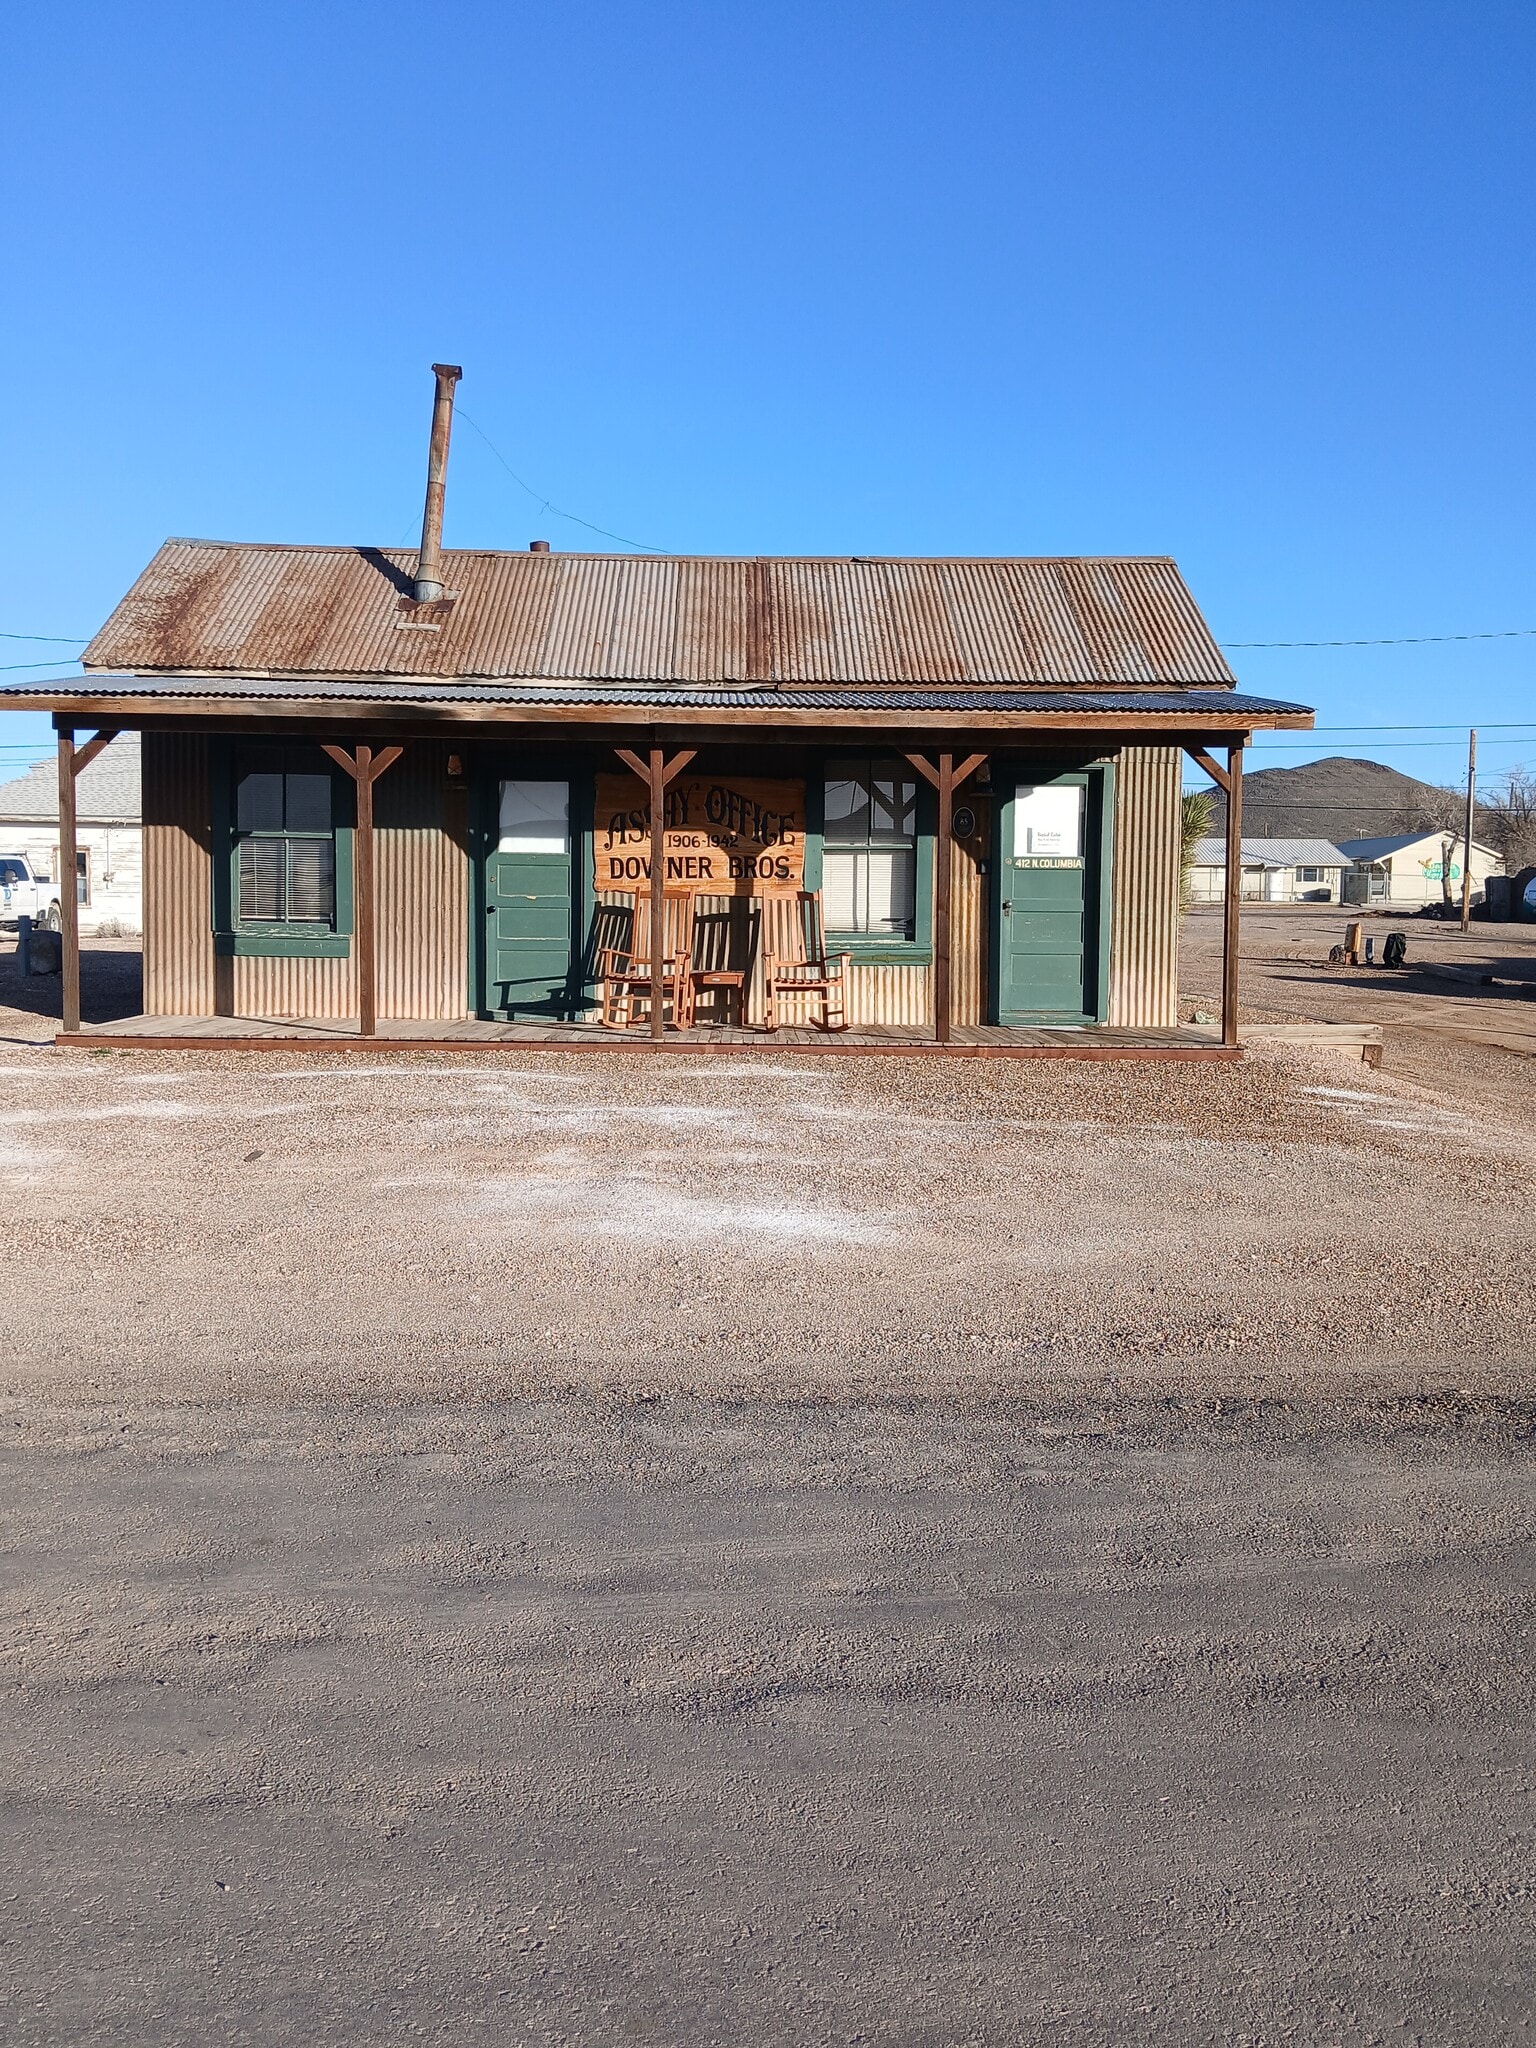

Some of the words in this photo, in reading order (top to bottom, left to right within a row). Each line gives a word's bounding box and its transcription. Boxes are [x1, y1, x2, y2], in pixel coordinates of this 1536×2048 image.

[704, 785, 795, 847] OFFICE
[728, 855, 795, 879] BROS.
[1015, 858, 1031, 868] 412
[1039, 858, 1082, 869] COLUMBIA
